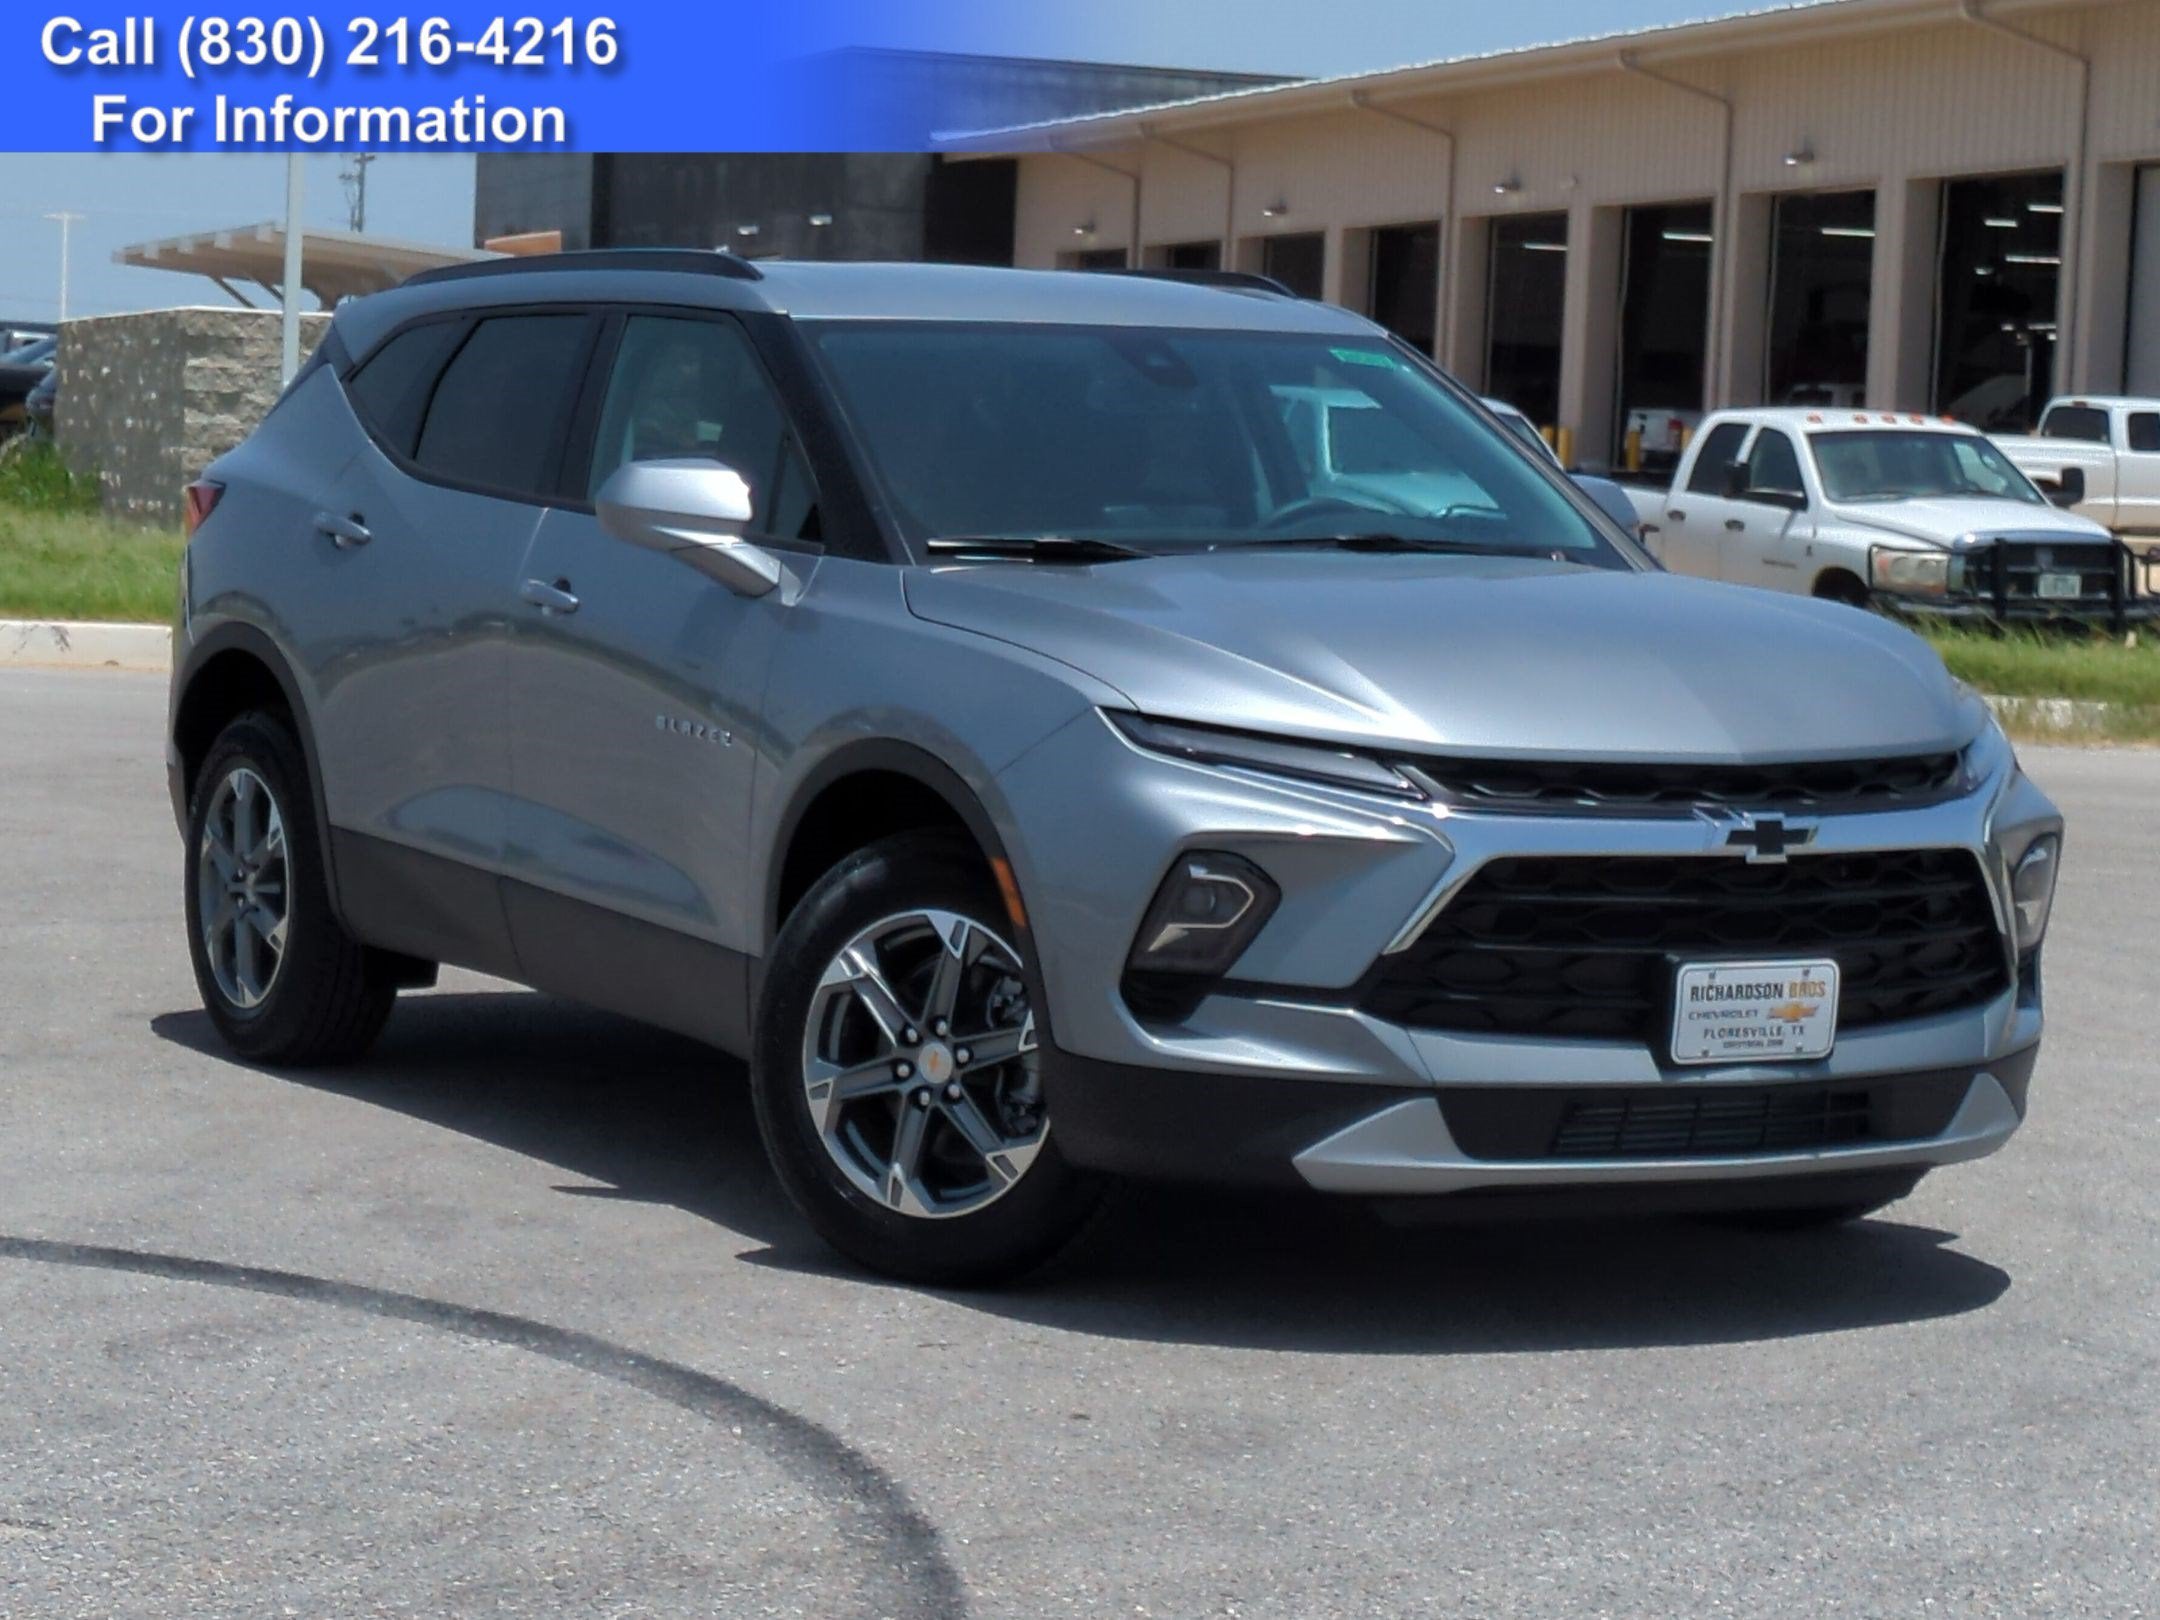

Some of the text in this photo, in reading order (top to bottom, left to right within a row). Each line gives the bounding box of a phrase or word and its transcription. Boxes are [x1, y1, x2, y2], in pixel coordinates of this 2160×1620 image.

[1690, 980, 1827, 1001] RICHARDSON BROS
[1688, 1008, 1759, 1021] CHEVROLET
